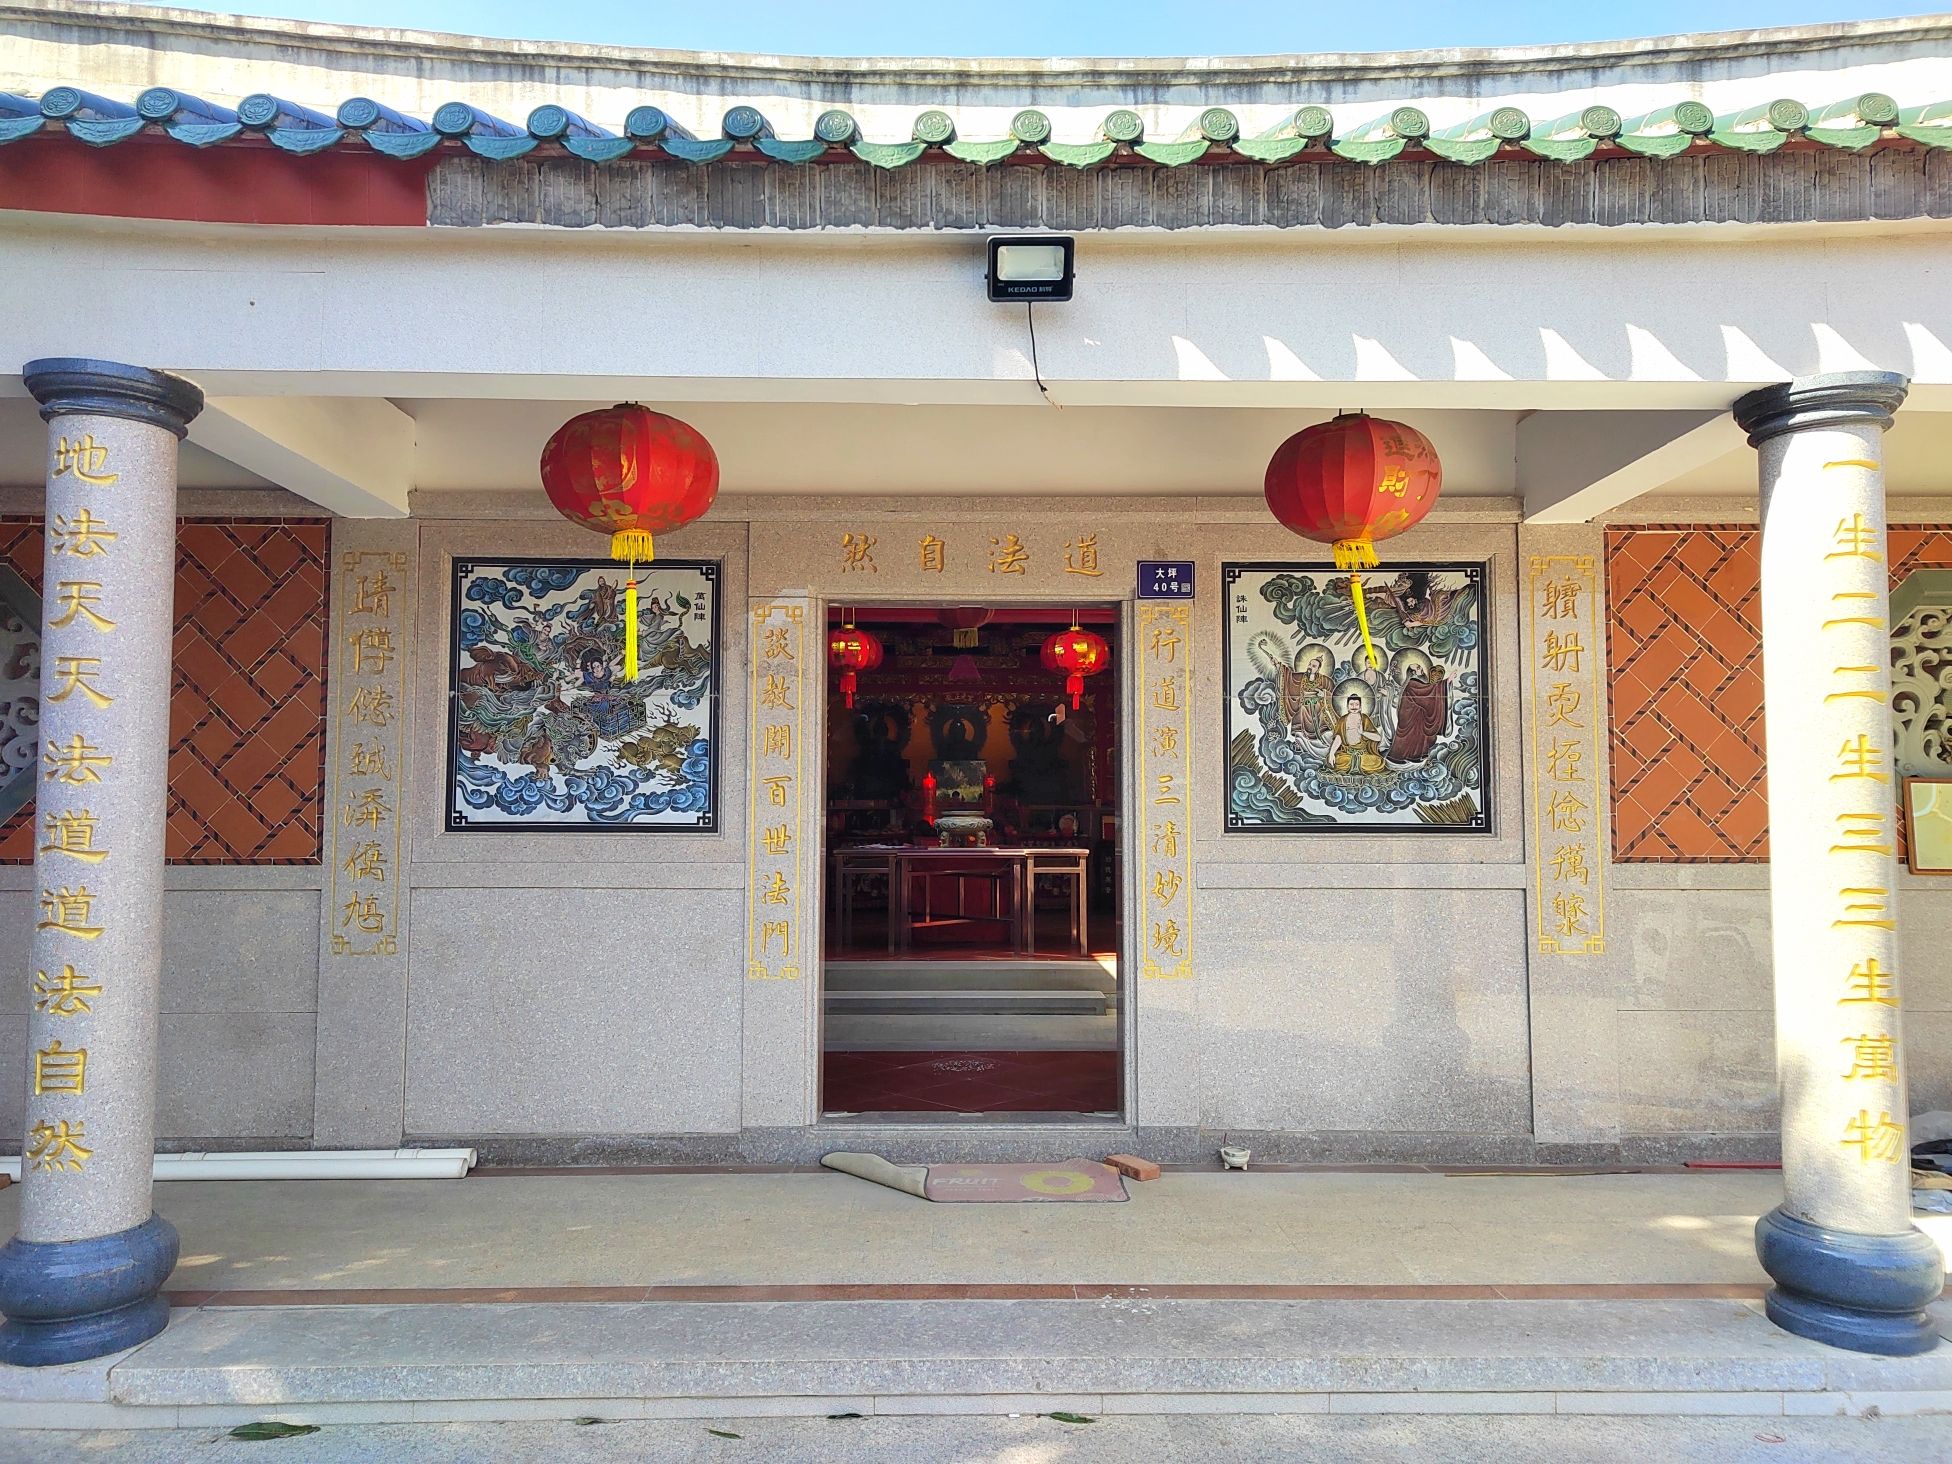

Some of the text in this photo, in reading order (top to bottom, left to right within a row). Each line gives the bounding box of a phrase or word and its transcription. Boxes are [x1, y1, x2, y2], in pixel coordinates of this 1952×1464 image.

[694, 592, 707, 622] 萬仙陣
[1153, 581, 1180, 593] 40号
[1155, 567, 1178, 579] 大坪
[25, 434, 120, 1173] 地法天天法道道法自然
[1151, 628, 1183, 957] 行道演三清妙境
[1821, 459, 1905, 1166] 一生二二生三三生萬物
